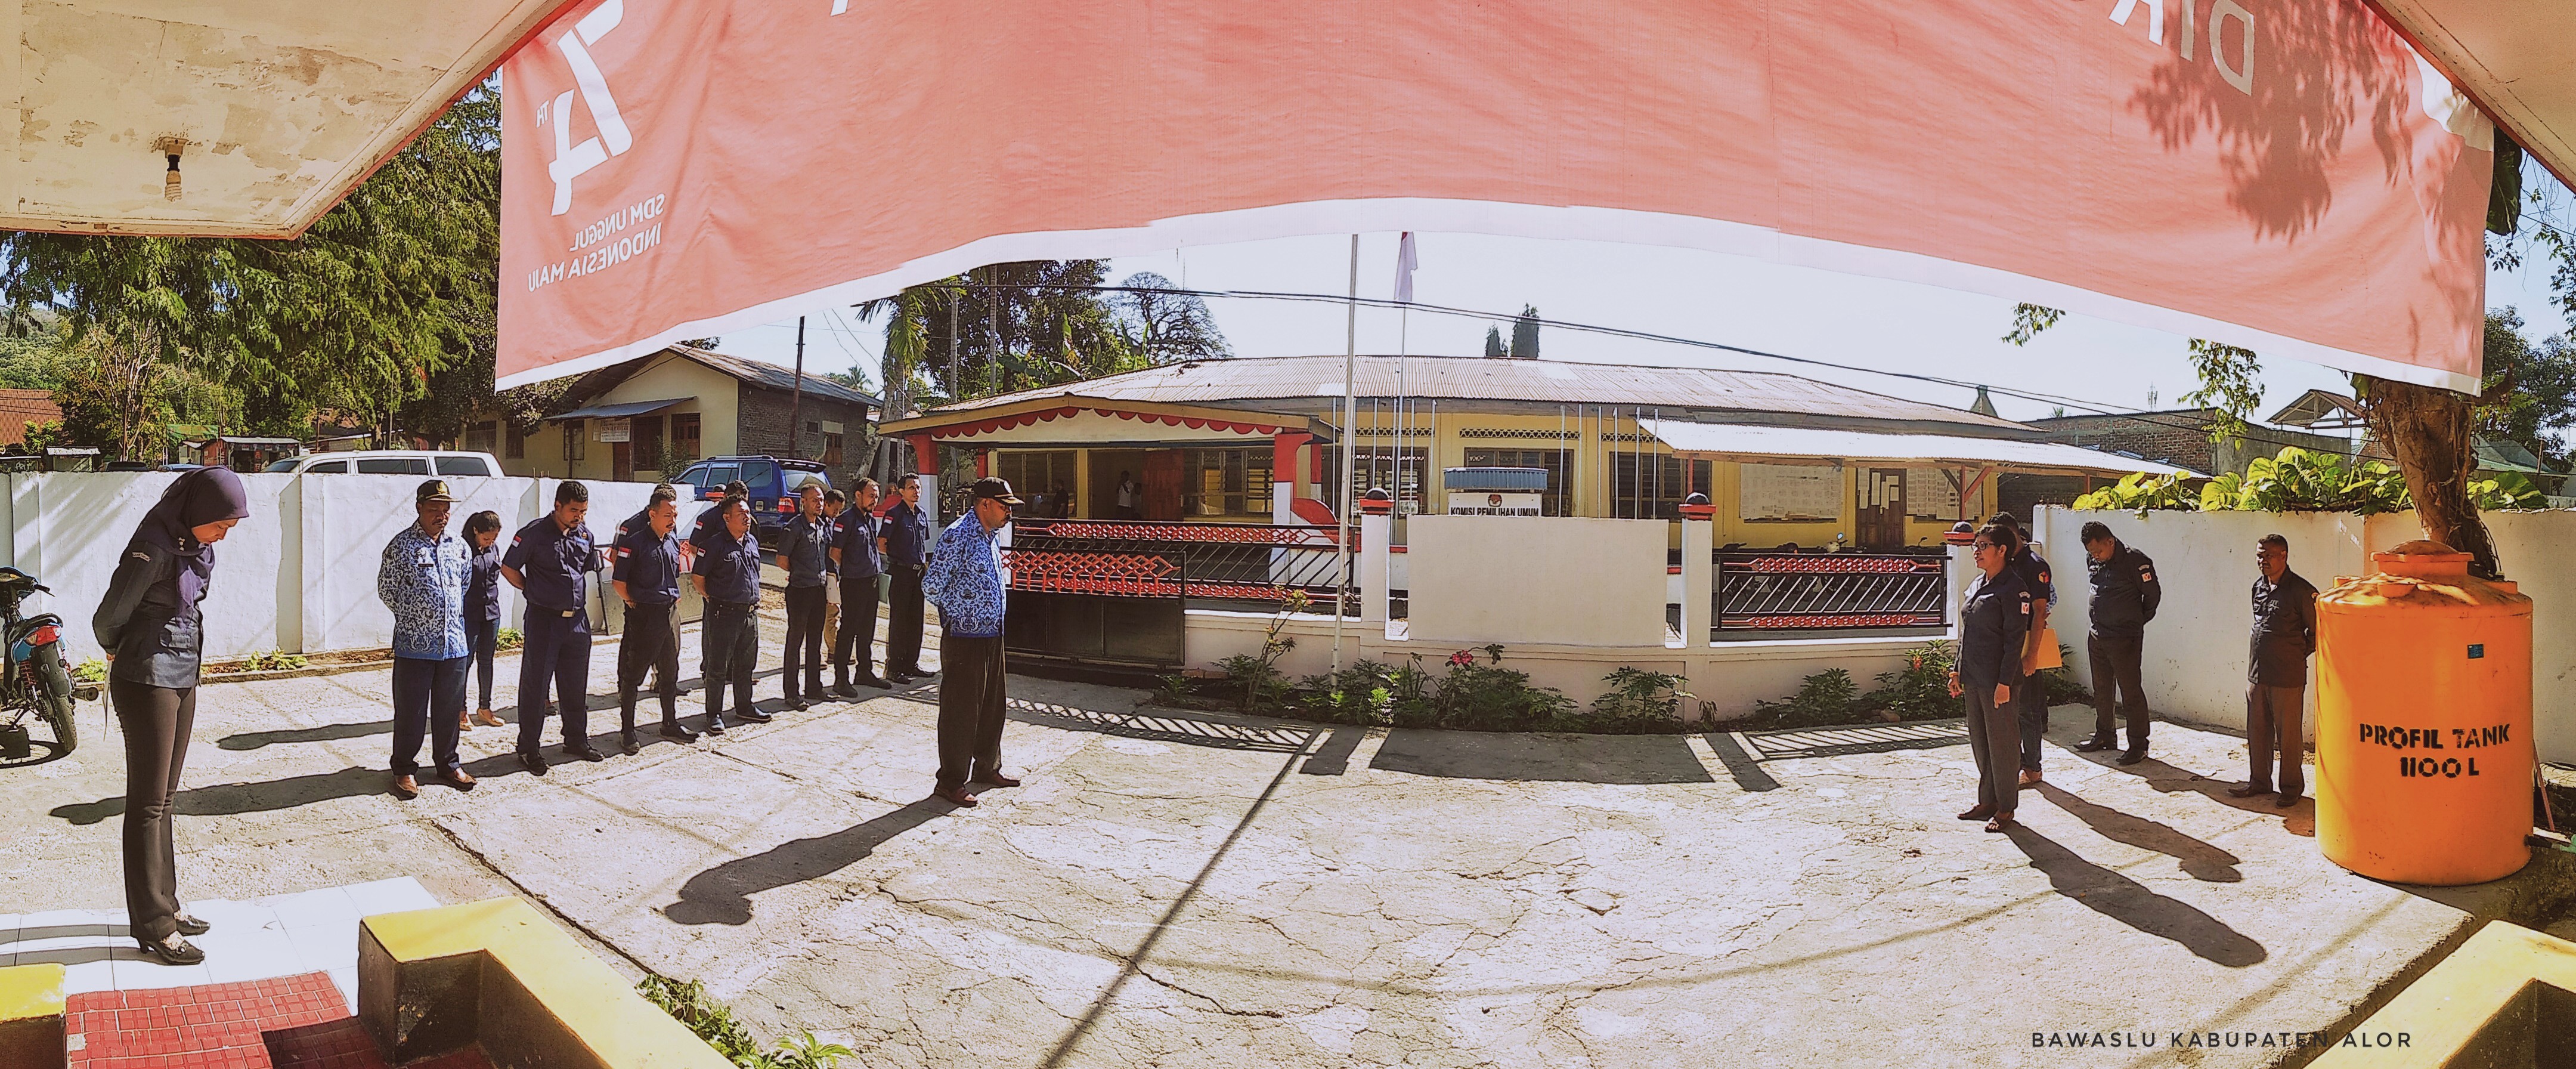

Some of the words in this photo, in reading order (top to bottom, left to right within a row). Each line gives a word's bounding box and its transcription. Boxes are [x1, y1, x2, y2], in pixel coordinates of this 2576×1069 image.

[1477, 508, 1515, 516] PEMILIHAN
[1518, 508, 1538, 517] UMUM
[2360, 723, 2443, 749] PROFIL
[2452, 724, 2510, 749] TANK
[2468, 758, 2479, 776] L
